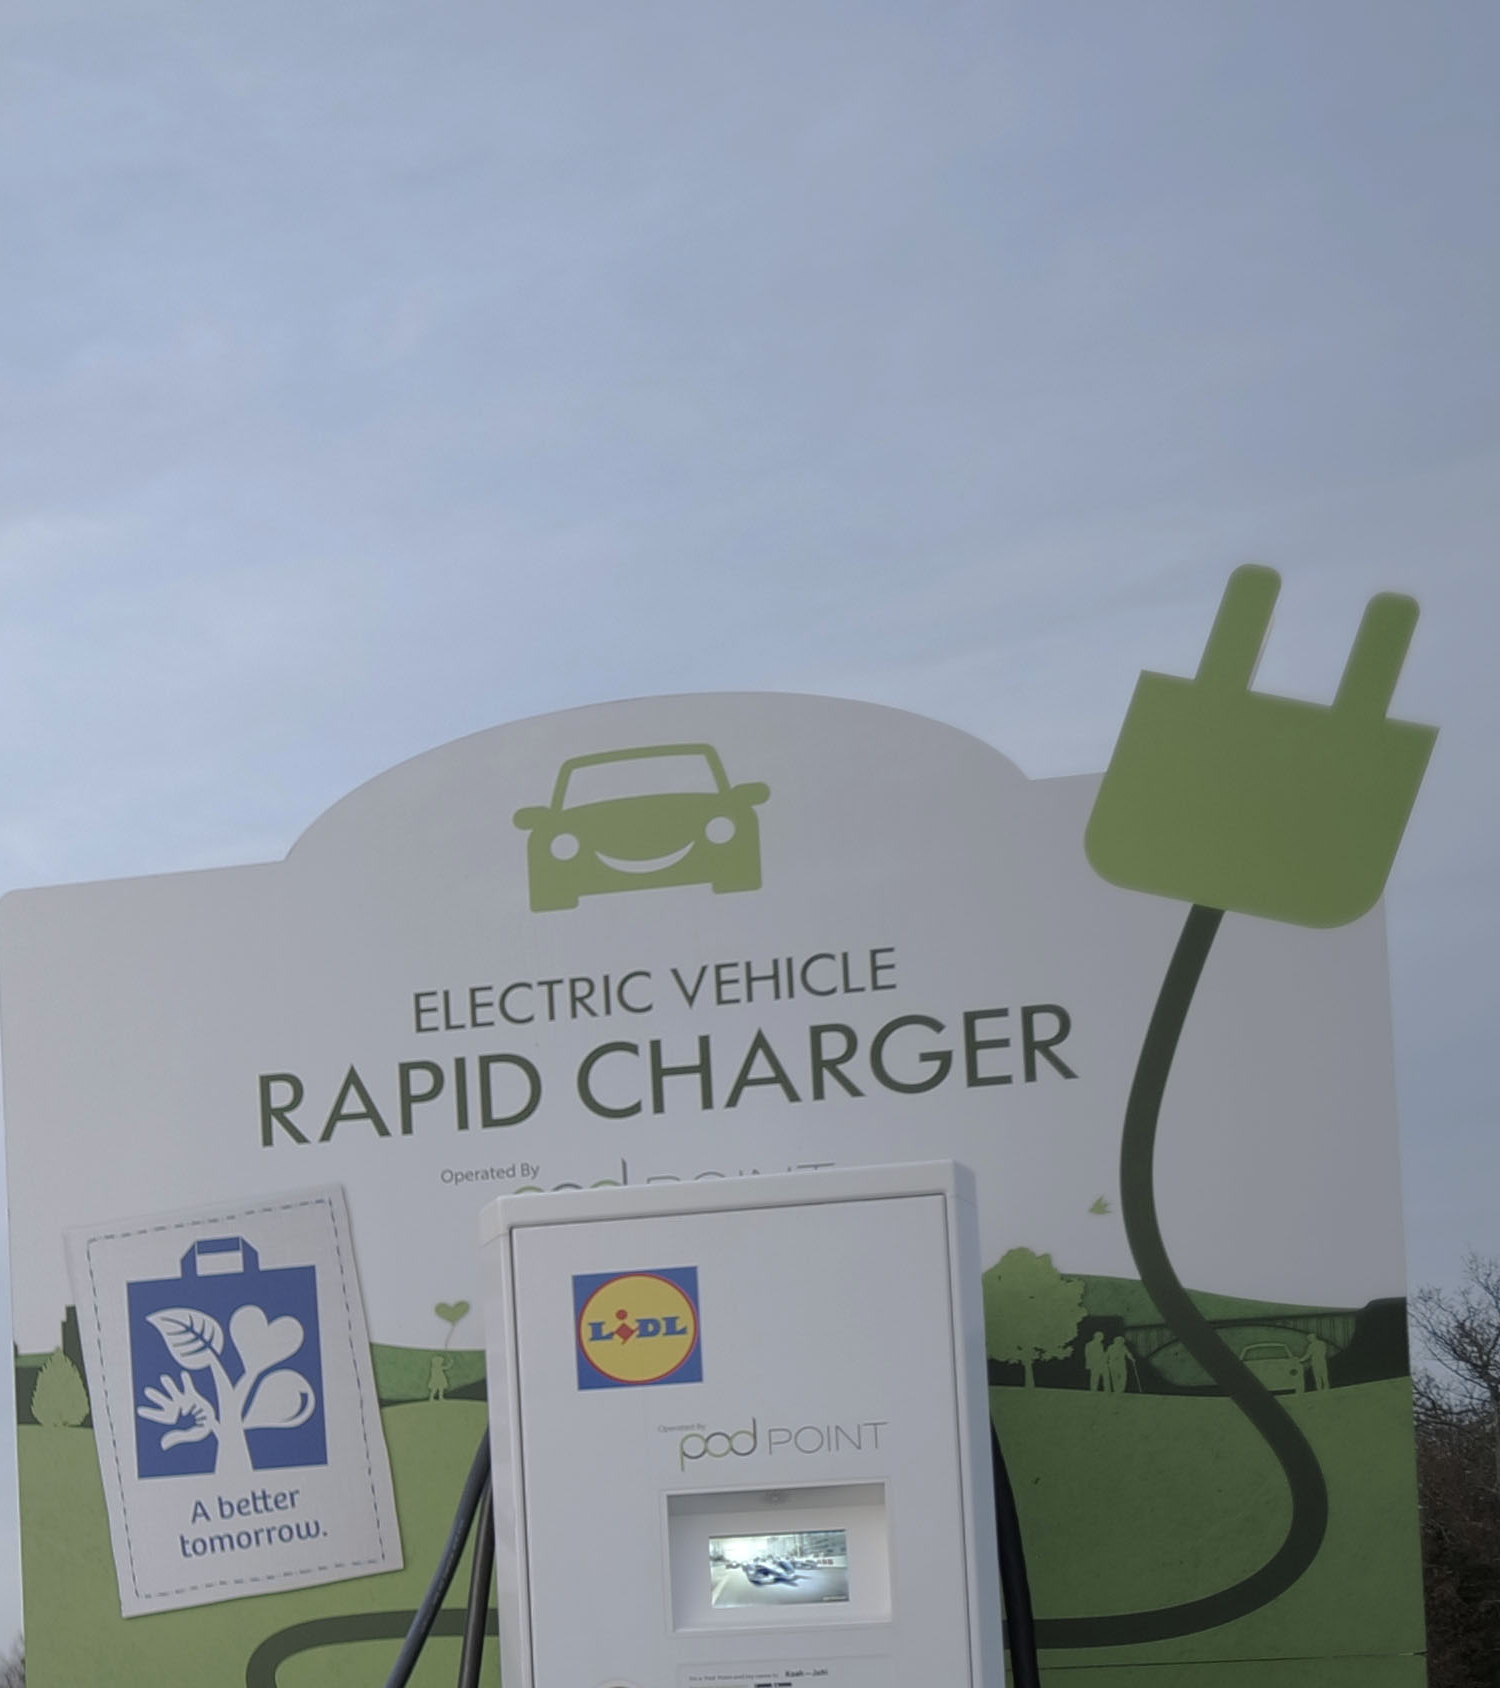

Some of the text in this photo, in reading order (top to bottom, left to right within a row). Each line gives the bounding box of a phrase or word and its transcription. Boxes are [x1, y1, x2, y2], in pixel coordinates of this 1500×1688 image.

[411, 946, 899, 1034] ELECTRIC VEHICLE
[256, 1002, 1081, 1148] RAPID CHARGER
[440, 1165, 516, 1185] Operated
[520, 1163, 541, 1180] By
[678, 1416, 889, 1472] pod POINT
[190, 1489, 300, 1525] A better
[179, 1520, 328, 1559] tomorrow.
